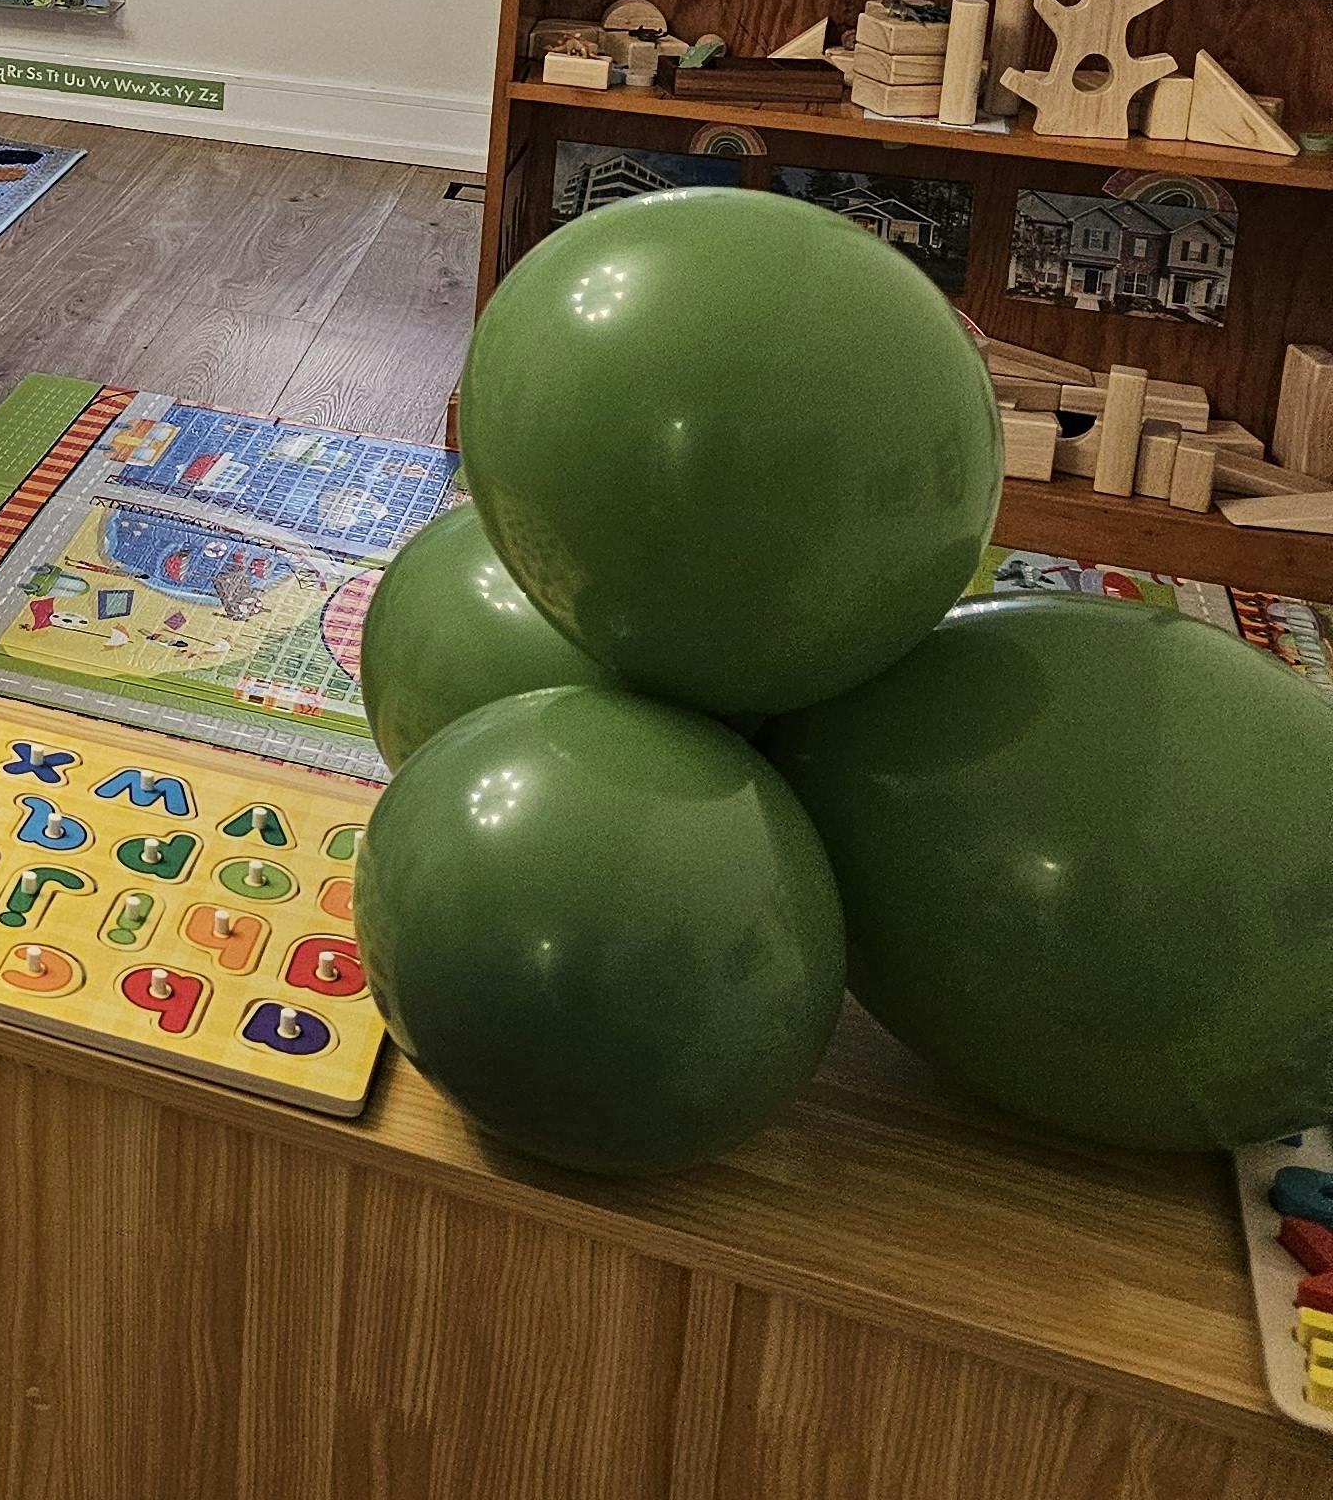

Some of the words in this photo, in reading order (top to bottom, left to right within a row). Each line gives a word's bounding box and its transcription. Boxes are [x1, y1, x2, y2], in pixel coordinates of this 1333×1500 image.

[7, 64, 23, 78] Rr
[26, 67, 42, 80] Ss
[46, 69, 59, 82] Tt
[65, 73, 85, 87] Uu
[89, 75, 109, 89] Vv
[114, 78, 146, 93] Ww
[149, 82, 171, 97] Xx
[175, 85, 194, 103] Yy
[198, 88, 218, 102] Zz
